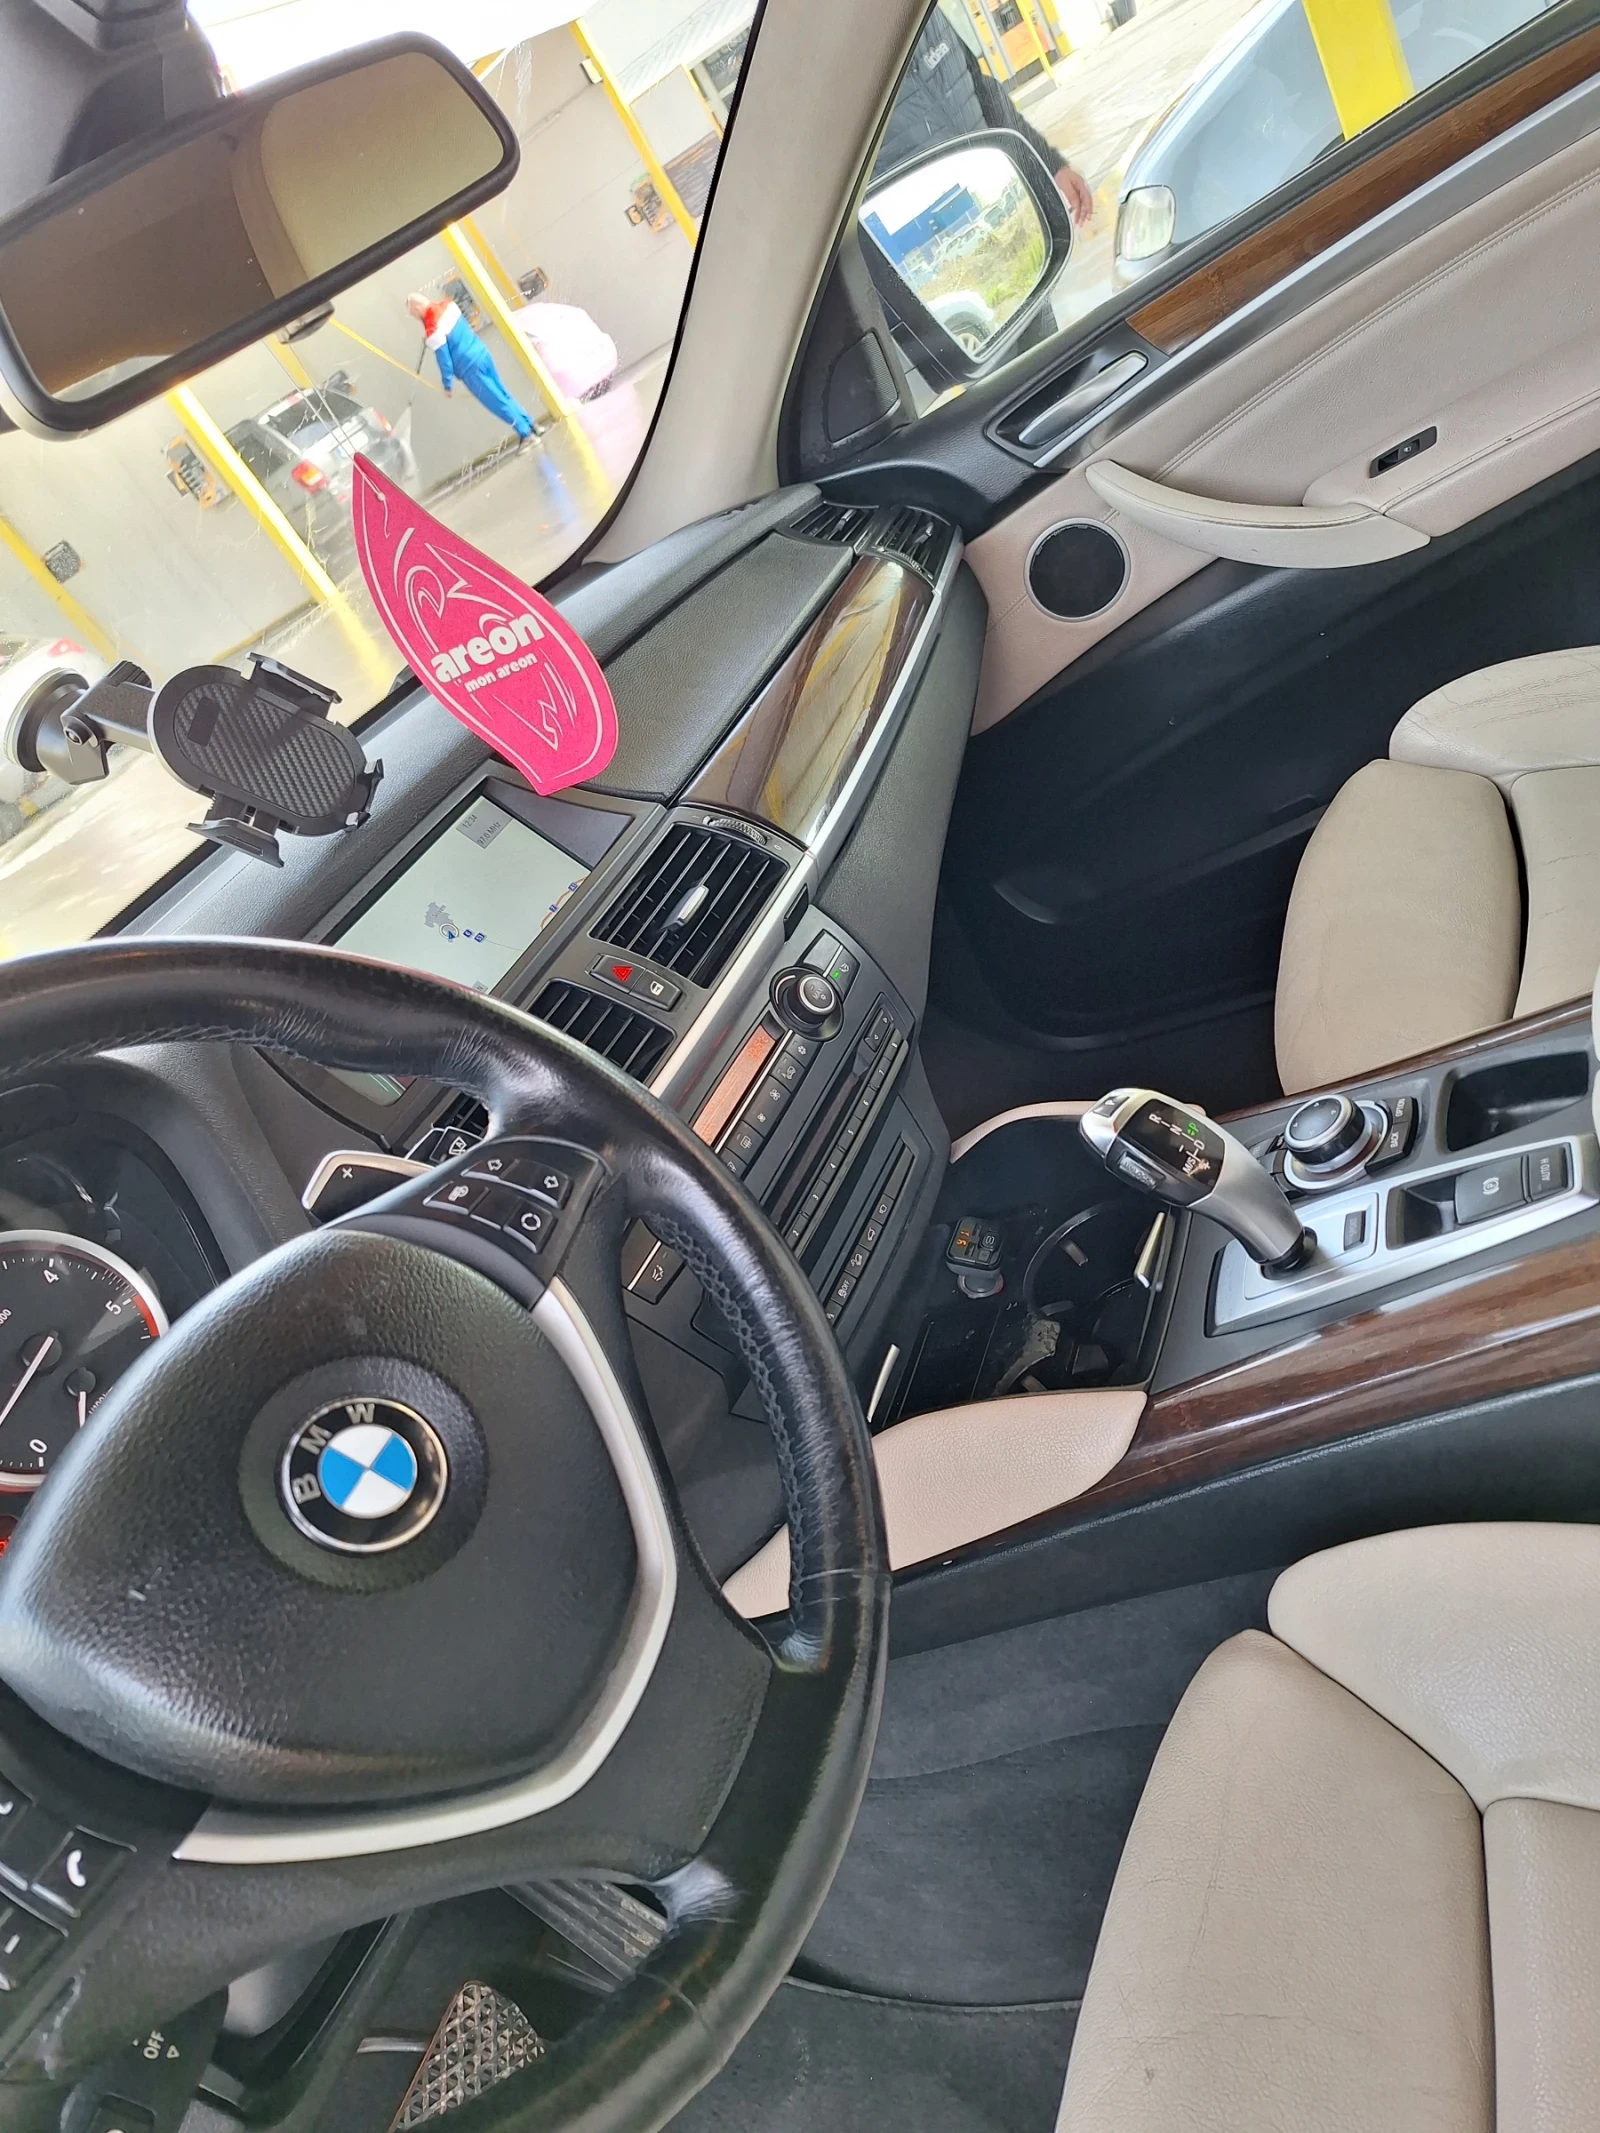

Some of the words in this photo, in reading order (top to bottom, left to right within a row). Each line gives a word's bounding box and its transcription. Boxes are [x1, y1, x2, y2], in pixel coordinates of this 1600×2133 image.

[430, 613, 545, 683] areon
[464, 671, 497, 693] mon
[495, 653, 538, 679] areon
[1395, 1098, 1405, 1118] OPTION
[1148, 1113, 1162, 1125] R
[1169, 1124, 1184, 1136] N
[1193, 1139, 1205, 1152] D
[1390, 1131, 1400, 1148] BACK
[829, 1162, 836, 1170] 4
[1182, 1157, 1196, 1176] M/S
[792, 1229, 800, 1237] 2
[42, 1269, 60, 1284] 4
[105, 1299, 122, 1316] 5
[29, 1438, 48, 1455] 0
[292, 1403, 376, 1504] BMW
[143, 2030, 165, 2060] OFF
